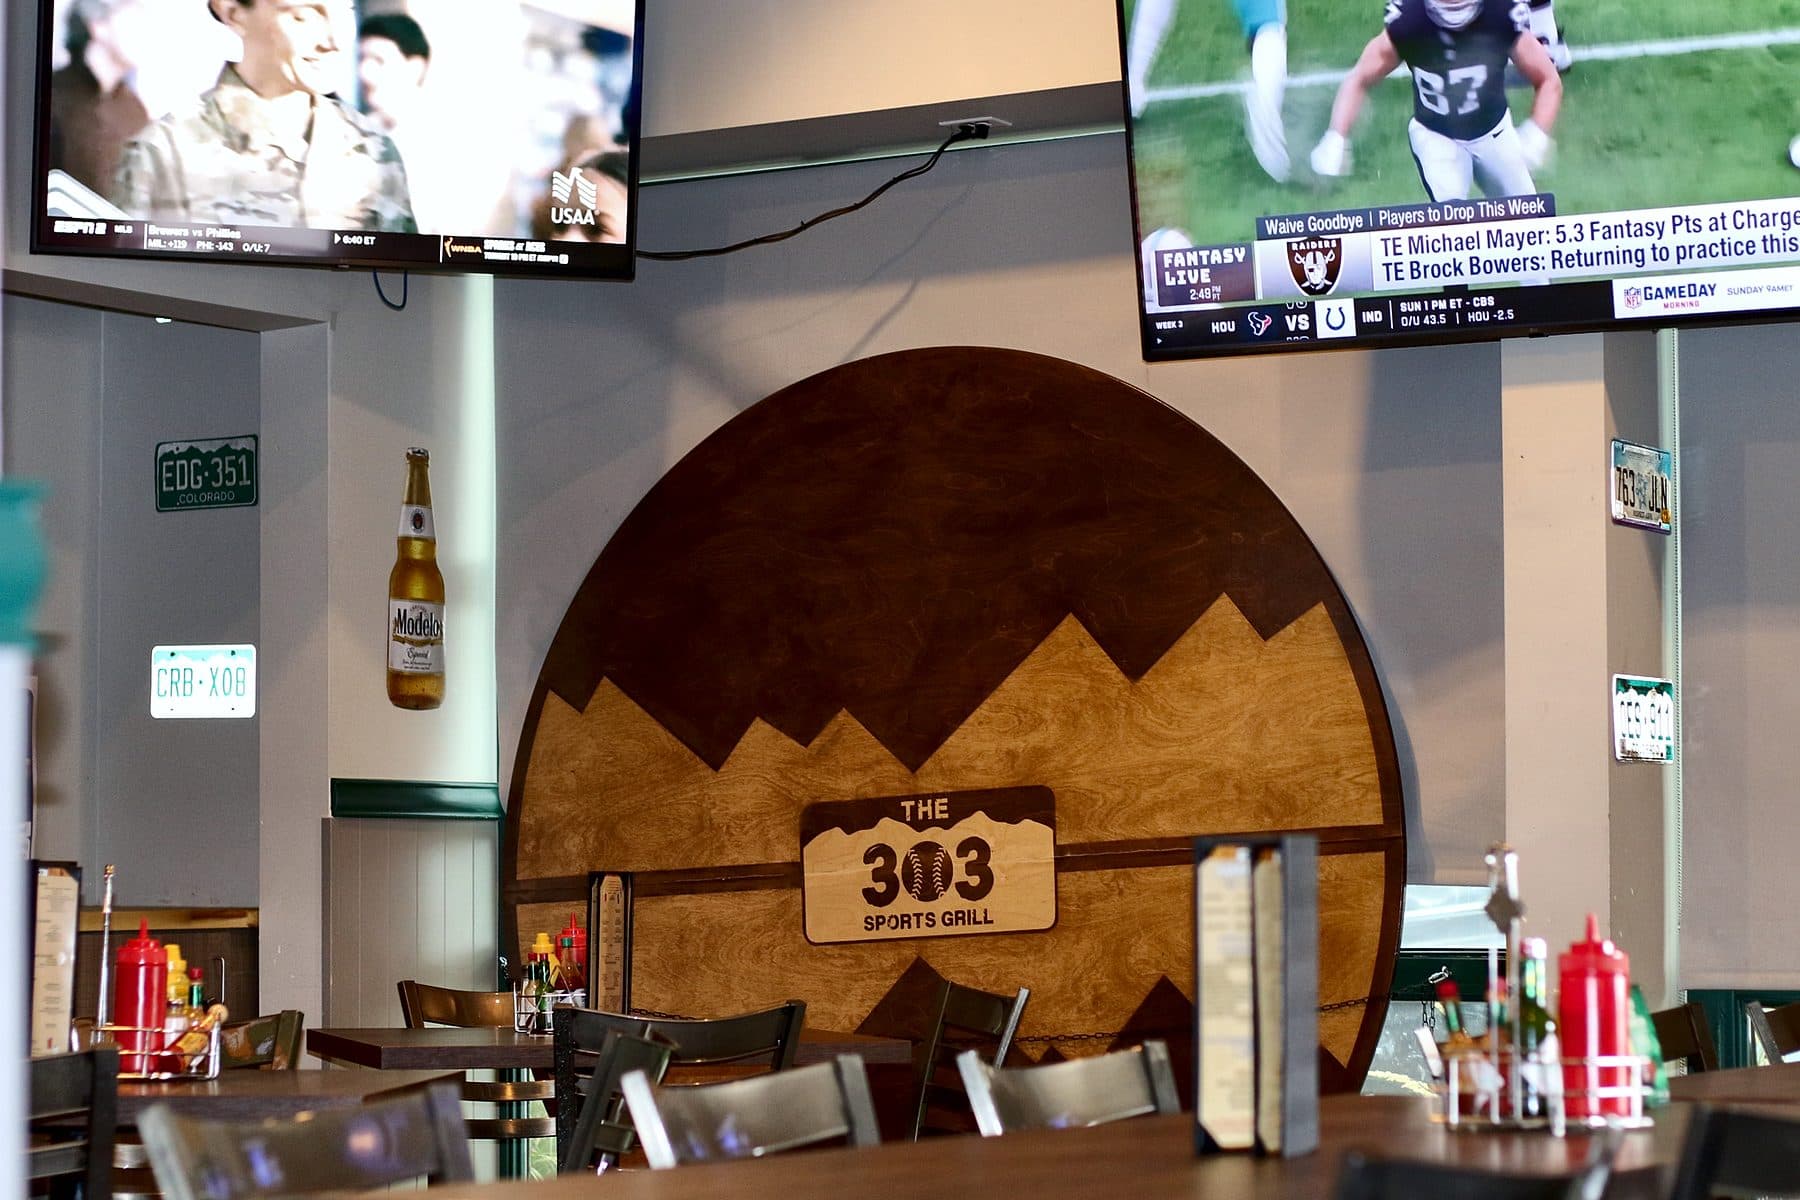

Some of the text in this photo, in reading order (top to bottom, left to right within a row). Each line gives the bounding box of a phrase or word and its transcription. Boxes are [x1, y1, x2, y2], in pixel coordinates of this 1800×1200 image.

[551, 207, 595, 225] USAA
[1265, 197, 1546, 236] Waive Goodbye Players to Drop This Week
[148, 225, 241, 239] Brewers vs Phillies
[364, 236, 376, 245] ET
[1380, 236, 1403, 257] TE
[1408, 231, 1480, 255] Michael
[1487, 229, 1551, 251] Mayer:
[1556, 223, 1585, 243] 5.3
[1590, 219, 1665, 241] Fantasy
[1672, 214, 1702, 235] Pts
[1708, 212, 1728, 232] at
[451, 244, 482, 254] WNBA
[1291, 239, 1337, 251] RAIDERS
[1163, 247, 1246, 268] FANTASY
[1382, 233, 1799, 282] TE Brock Bowers: Returning to practice this
[1165, 268, 1211, 286] LIVE
[1727, 286, 1764, 296] SUNDAY
[1400, 301, 1421, 312] SUN
[1424, 300, 1429, 311] 1
[1431, 299, 1447, 310] PM
[1449, 298, 1463, 309] ET
[1473, 296, 1495, 307] CBS
[1663, 301, 1700, 309] MORNING
[1211, 310, 1383, 333] HOU VS IND
[1423, 314, 1446, 325] 43.5
[1467, 309, 1515, 322] HOU -2.5
[1156, 320, 1183, 330] WEEK 3
[1616, 466, 1636, 508] 763
[179, 491, 235, 504] COLORADO
[397, 607, 440, 637] Modelo
[901, 798, 949, 822] THE
[864, 909, 994, 931] SPORTS GRILL
